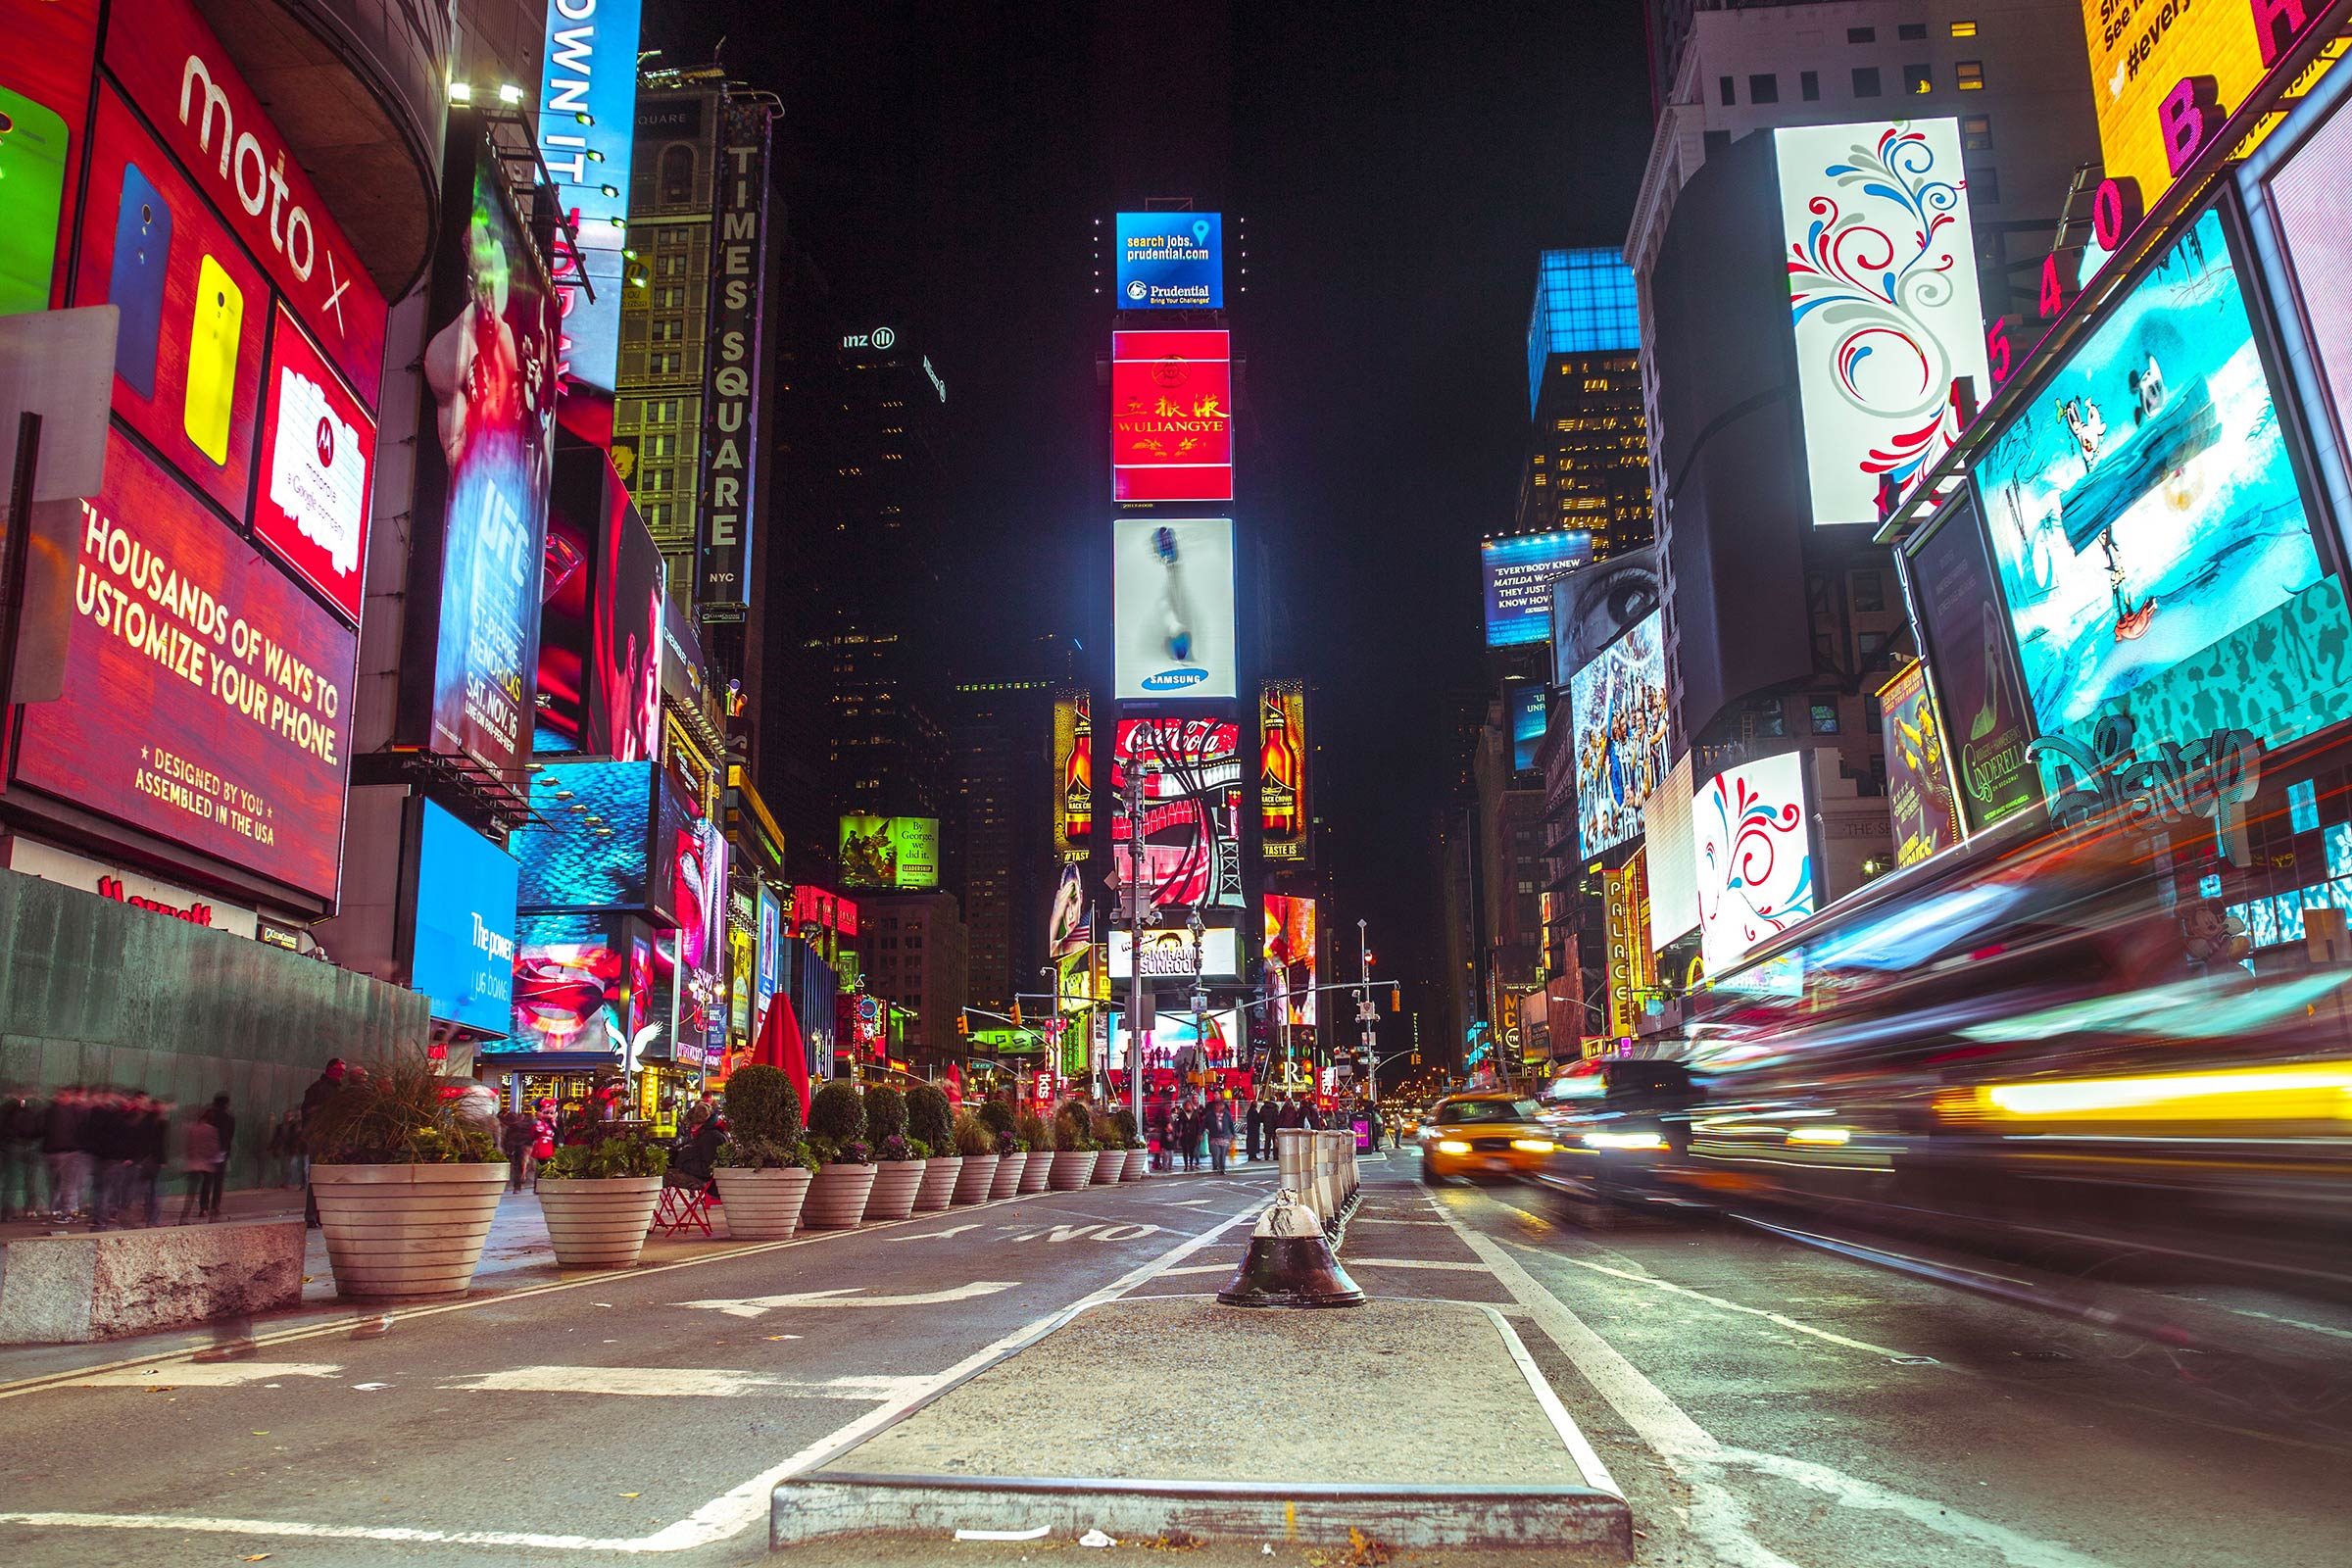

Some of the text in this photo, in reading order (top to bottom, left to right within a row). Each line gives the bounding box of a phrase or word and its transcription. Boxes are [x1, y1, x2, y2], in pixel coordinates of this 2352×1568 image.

[638, 113, 686, 125] QUARE
[179, 54, 315, 283] moto
[545, 135, 587, 184] IT
[722, 146, 759, 311] TIMES
[1127, 234, 1193, 249] search jobs.
[1127, 248, 1209, 263] prudential.com
[1150, 285, 1209, 297] Prudential
[1119, 420, 1224, 432] WULIANGYE
[711, 330, 750, 546] SQUARE
[481, 478, 530, 588] UFC
[1552, 559, 1581, 569] KNEW
[710, 572, 735, 583] NYC
[1493, 574, 1533, 587] MATILDA
[1499, 584, 1546, 597] THEY JUST
[1498, 598, 1528, 609] KNOW
[473, 601, 519, 670] ST-PIERRE
[75, 565, 338, 766] USTOMIZE YOUR PHONE.
[231, 619, 261, 668] OF
[265, 638, 315, 705] WAYS
[316, 676, 339, 718] TO
[469, 629, 521, 702] HENDRICKS
[1150, 674, 1200, 685] SAMSUNG
[465, 700, 477, 721] LIVE
[476, 711, 485, 727] ON
[466, 671, 486, 710] SAT.
[487, 690, 508, 731] NOV.
[509, 711, 517, 740] 16
[154, 746, 264, 817] DESIGNED BY YOU
[135, 767, 213, 824] ASSEMBLED
[231, 807, 253, 837] THE
[255, 817, 274, 847] USA
[901, 830, 934, 842] George,
[913, 821, 923, 832] By
[906, 850, 919, 858] did
[1264, 845, 1297, 856] TASTE IS
[471, 911, 489, 952] The
[1610, 881, 1628, 1001] PALACE
[1038, 1073, 1051, 1099] tkts
[1011, 1224, 1161, 1243] NO
